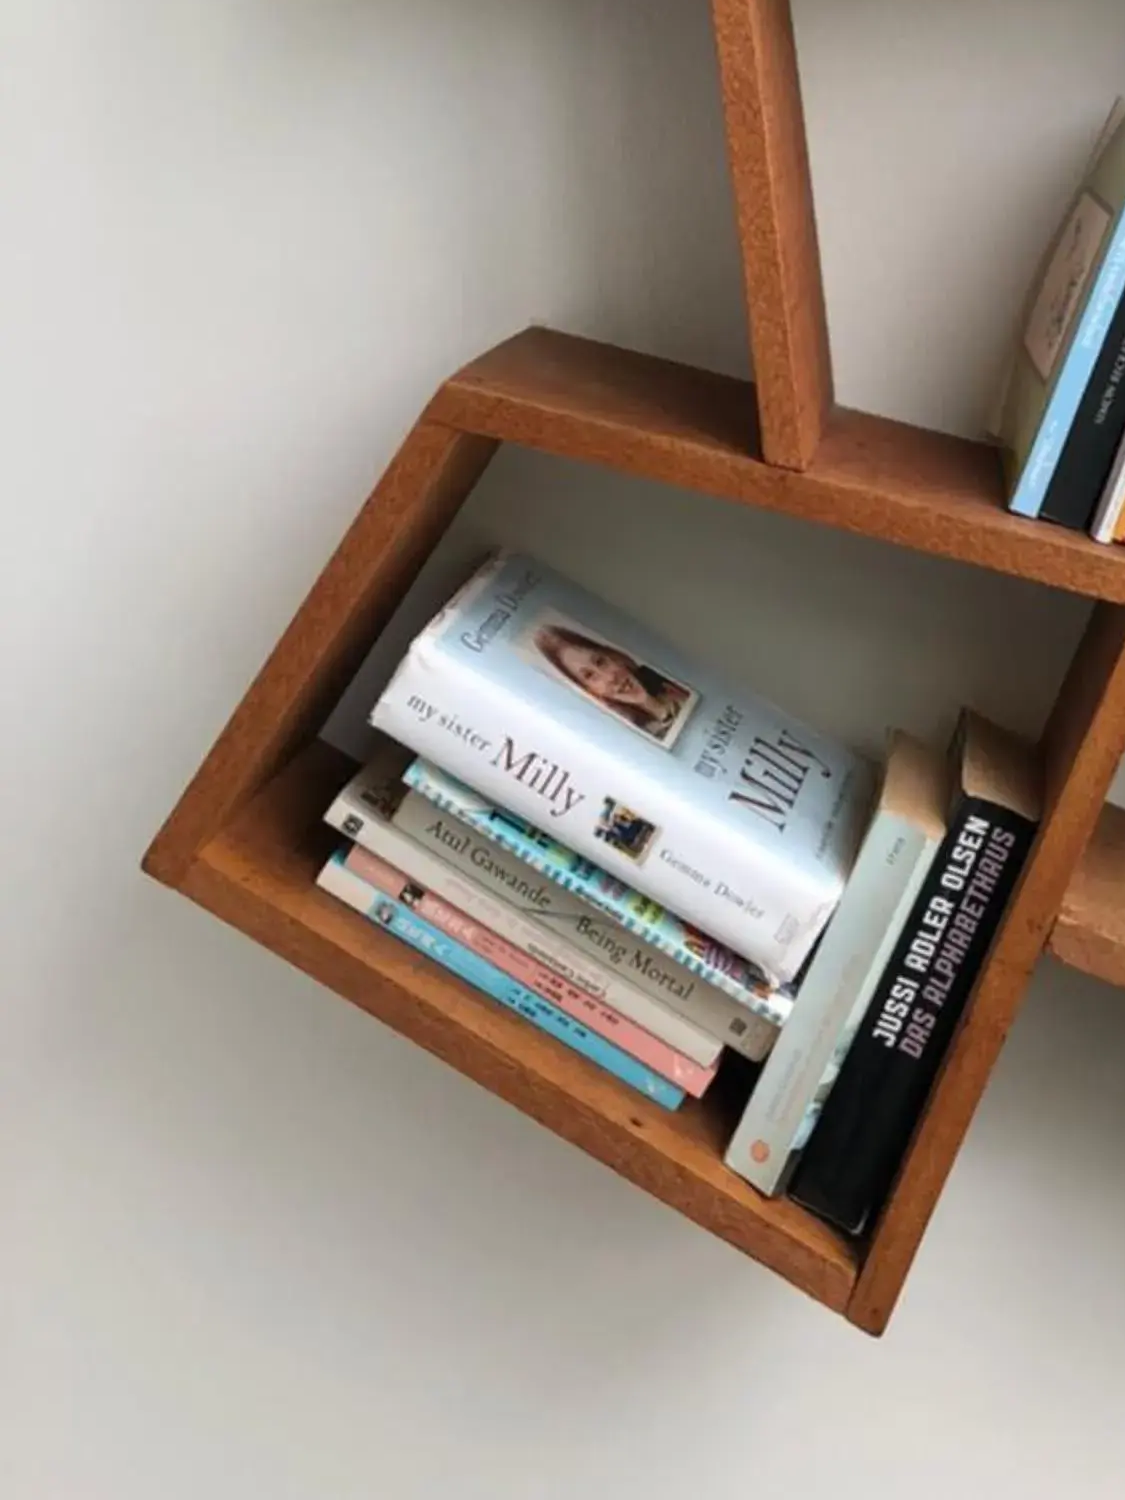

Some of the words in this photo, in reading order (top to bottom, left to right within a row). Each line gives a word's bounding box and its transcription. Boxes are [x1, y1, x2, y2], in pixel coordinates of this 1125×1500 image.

[1093, 385, 1115, 424] SIMON
[407, 694, 435, 721] my
[438, 710, 493, 752] sister
[495, 736, 584, 817] Milly
[707, 705, 741, 754] sister
[728, 725, 834, 833] Milly
[426, 818, 469, 852] Atul
[467, 846, 554, 908] Gawande
[572, 915, 629, 963] Being
[629, 950, 694, 999] Mortal
[872, 976, 919, 1049] JUSSI
[905, 896, 954, 971] ADLER
[940, 815, 992, 891] OLSEN
[898, 1008, 935, 1060] DAS
[922, 827, 1016, 1007] ALPHABETHAUS
